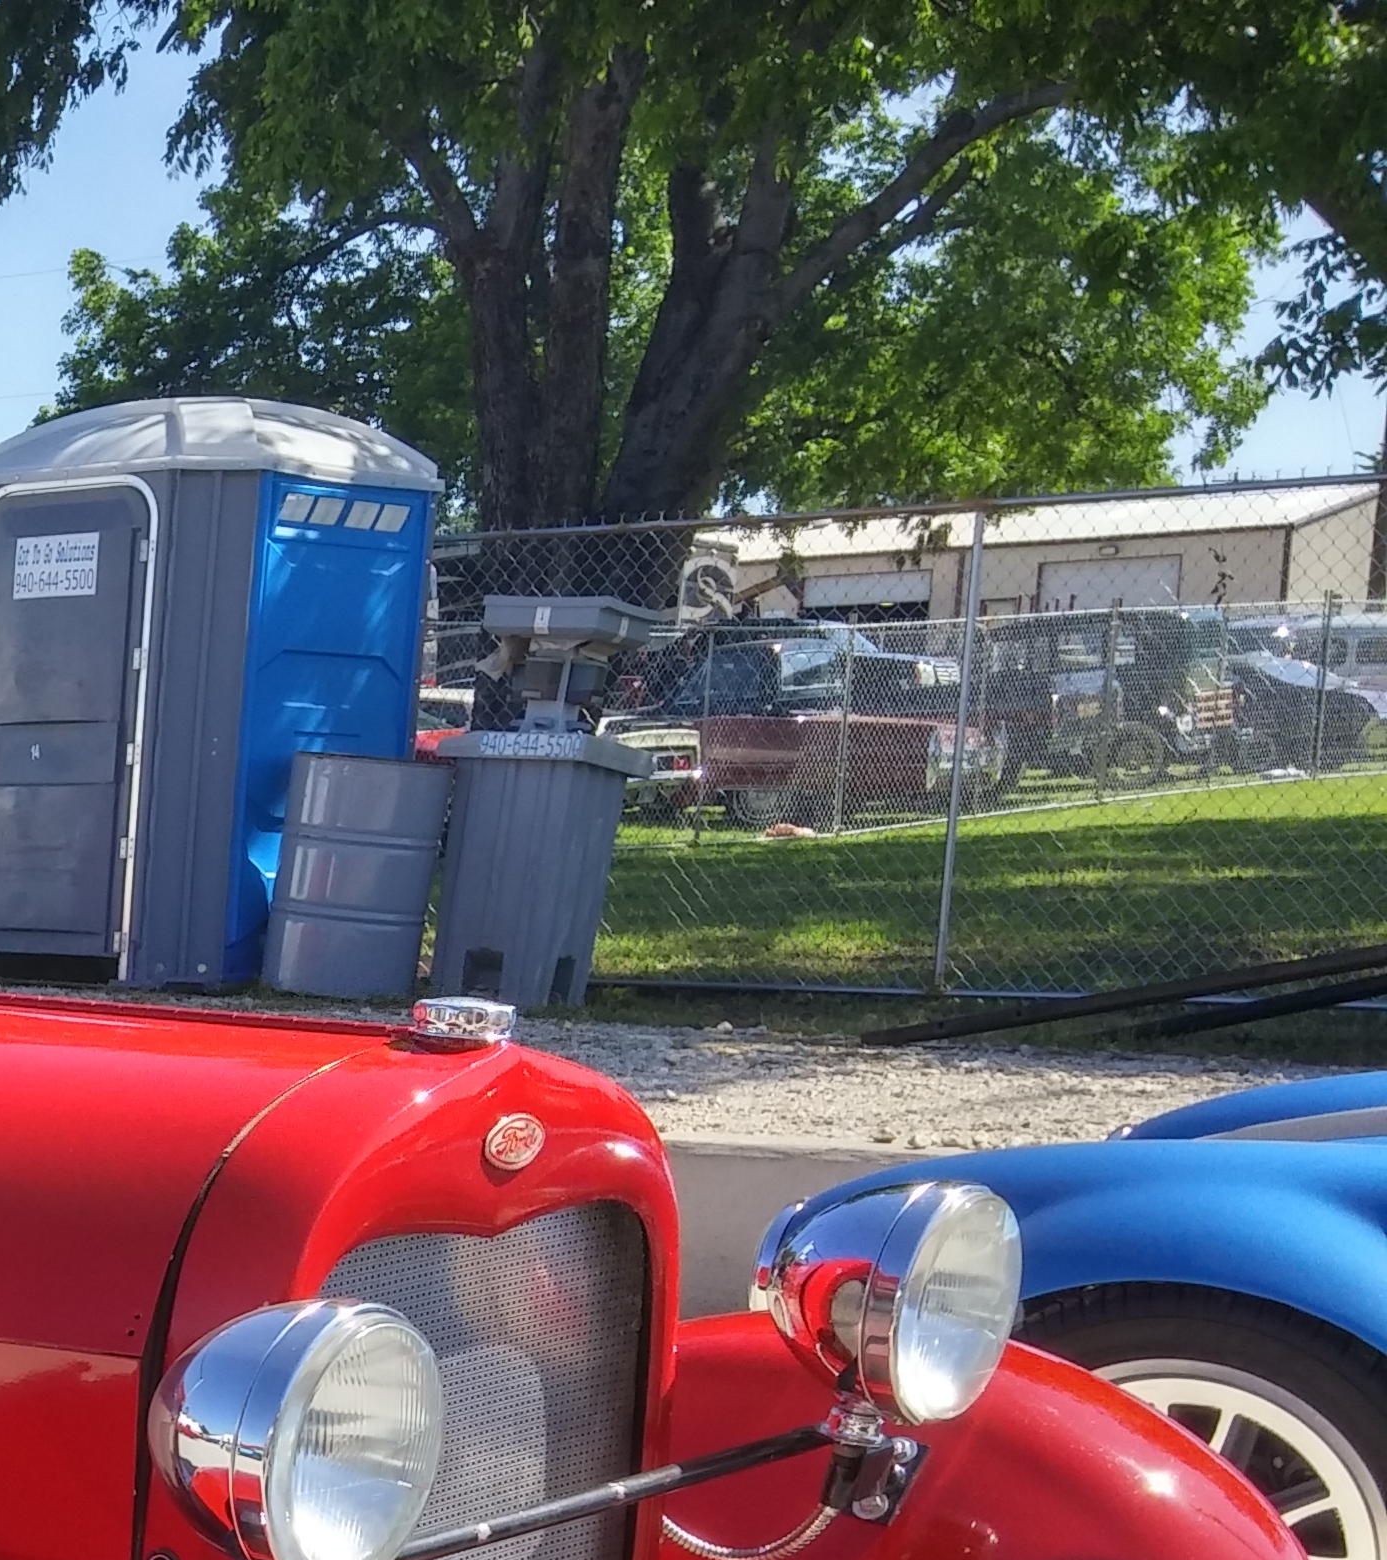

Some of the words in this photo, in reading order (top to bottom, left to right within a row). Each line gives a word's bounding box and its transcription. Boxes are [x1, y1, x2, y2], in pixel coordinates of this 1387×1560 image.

[55, 540, 96, 563] Solutions
[15, 569, 94, 593] 940-644-5500
[479, 731, 582, 758] 940-644-5500
[494, 1122, 538, 1154] Ford
